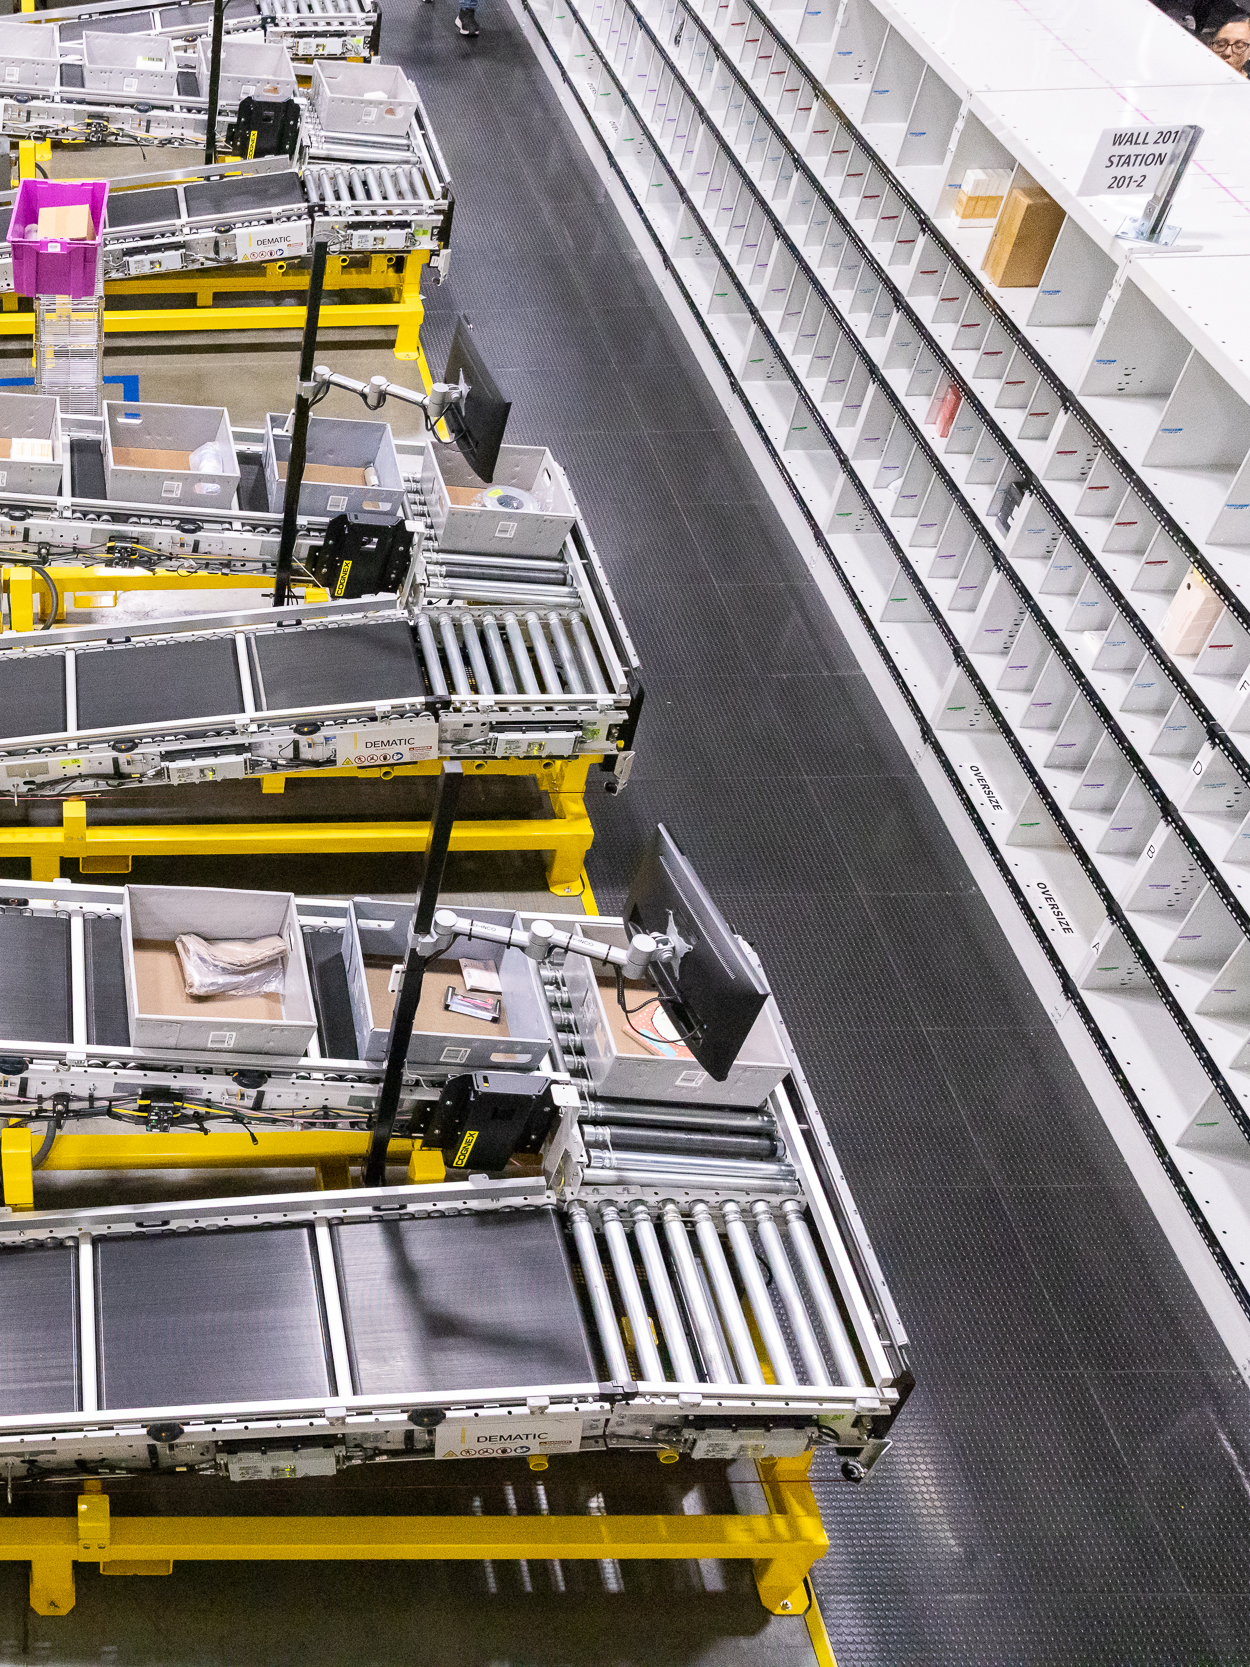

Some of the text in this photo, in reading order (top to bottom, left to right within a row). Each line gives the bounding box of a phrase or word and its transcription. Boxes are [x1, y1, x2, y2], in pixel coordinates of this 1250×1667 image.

[1112, 130, 1179, 146] WALL 201
[1105, 152, 1167, 168] STATION
[1107, 174, 1147, 189] 201-2
[256, 235, 291, 246] DEMATIC
[336, 561, 351, 596] COGNEX
[365, 737, 416, 749] DEMATIC
[1193, 760, 1203, 775] D
[969, 765, 1003, 811] OVERSIZE
[1146, 844, 1156, 859] B
[1036, 882, 1075, 935] OVERSIZE
[1092, 942, 1100, 955] A
[456, 1132, 477, 1166] COGNEX
[476, 1432, 549, 1443] DEMATIC
